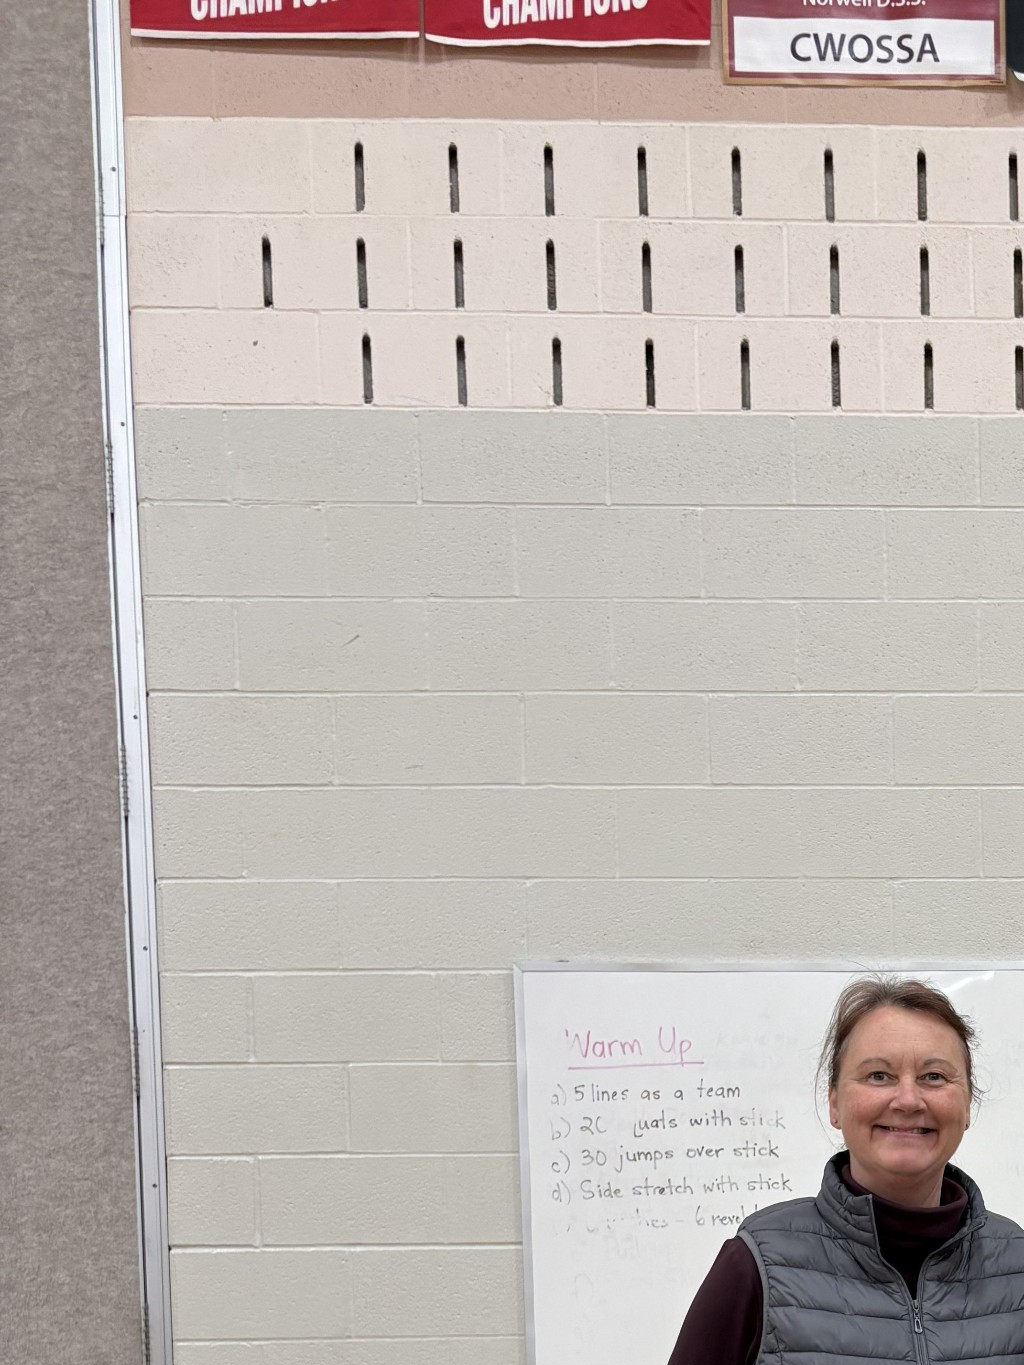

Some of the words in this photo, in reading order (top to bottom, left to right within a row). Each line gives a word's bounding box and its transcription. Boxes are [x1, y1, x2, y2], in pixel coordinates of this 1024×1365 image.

[790, 33, 939, 63] CWOSSA
[658, 1026, 692, 1067] Up
[550, 1083, 568, 1106] a)
[574, 1084, 586, 1103] 5
[591, 1083, 629, 1103] lines
[640, 1088, 661, 1101] as
[674, 1088, 684, 1101] a
[697, 1078, 741, 1099] team
[689, 1109, 732, 1128] with
[739, 1107, 786, 1130] stick
[551, 1150, 571, 1174] c)
[581, 1149, 607, 1167] 30
[615, 1145, 674, 1174] jumps
[686, 1147, 725, 1158] over
[733, 1140, 779, 1159] stick
[551, 1180, 571, 1206] d)
[580, 1179, 624, 1201] Side
[632, 1176, 694, 1197] stretch
[703, 1175, 740, 1194] with
[747, 1173, 793, 1194] stick
